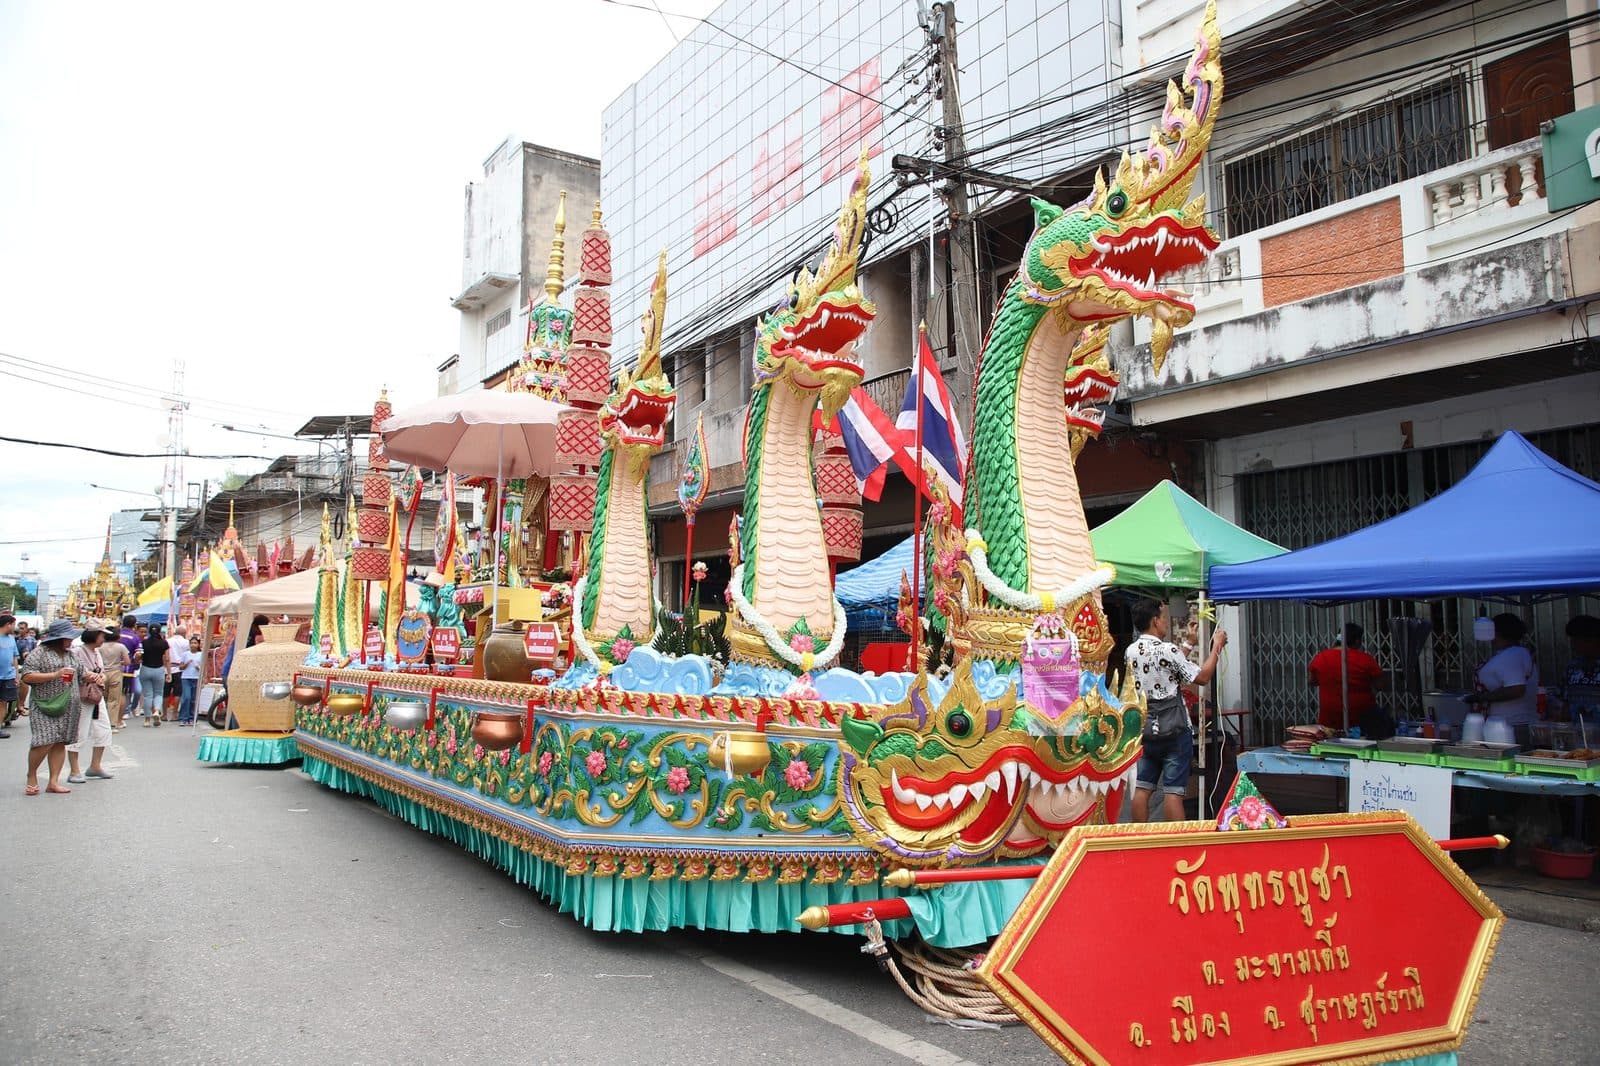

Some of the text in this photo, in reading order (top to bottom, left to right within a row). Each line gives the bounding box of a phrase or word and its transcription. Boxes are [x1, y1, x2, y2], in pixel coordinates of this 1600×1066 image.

[1168, 842, 1352, 934] วัดพุทธบูชา
[1201, 911, 1350, 986] ต. มะขามเตี้ย
[1129, 966, 1425, 1048] อ. เมือง จ. สุราษฎร์ธานี
